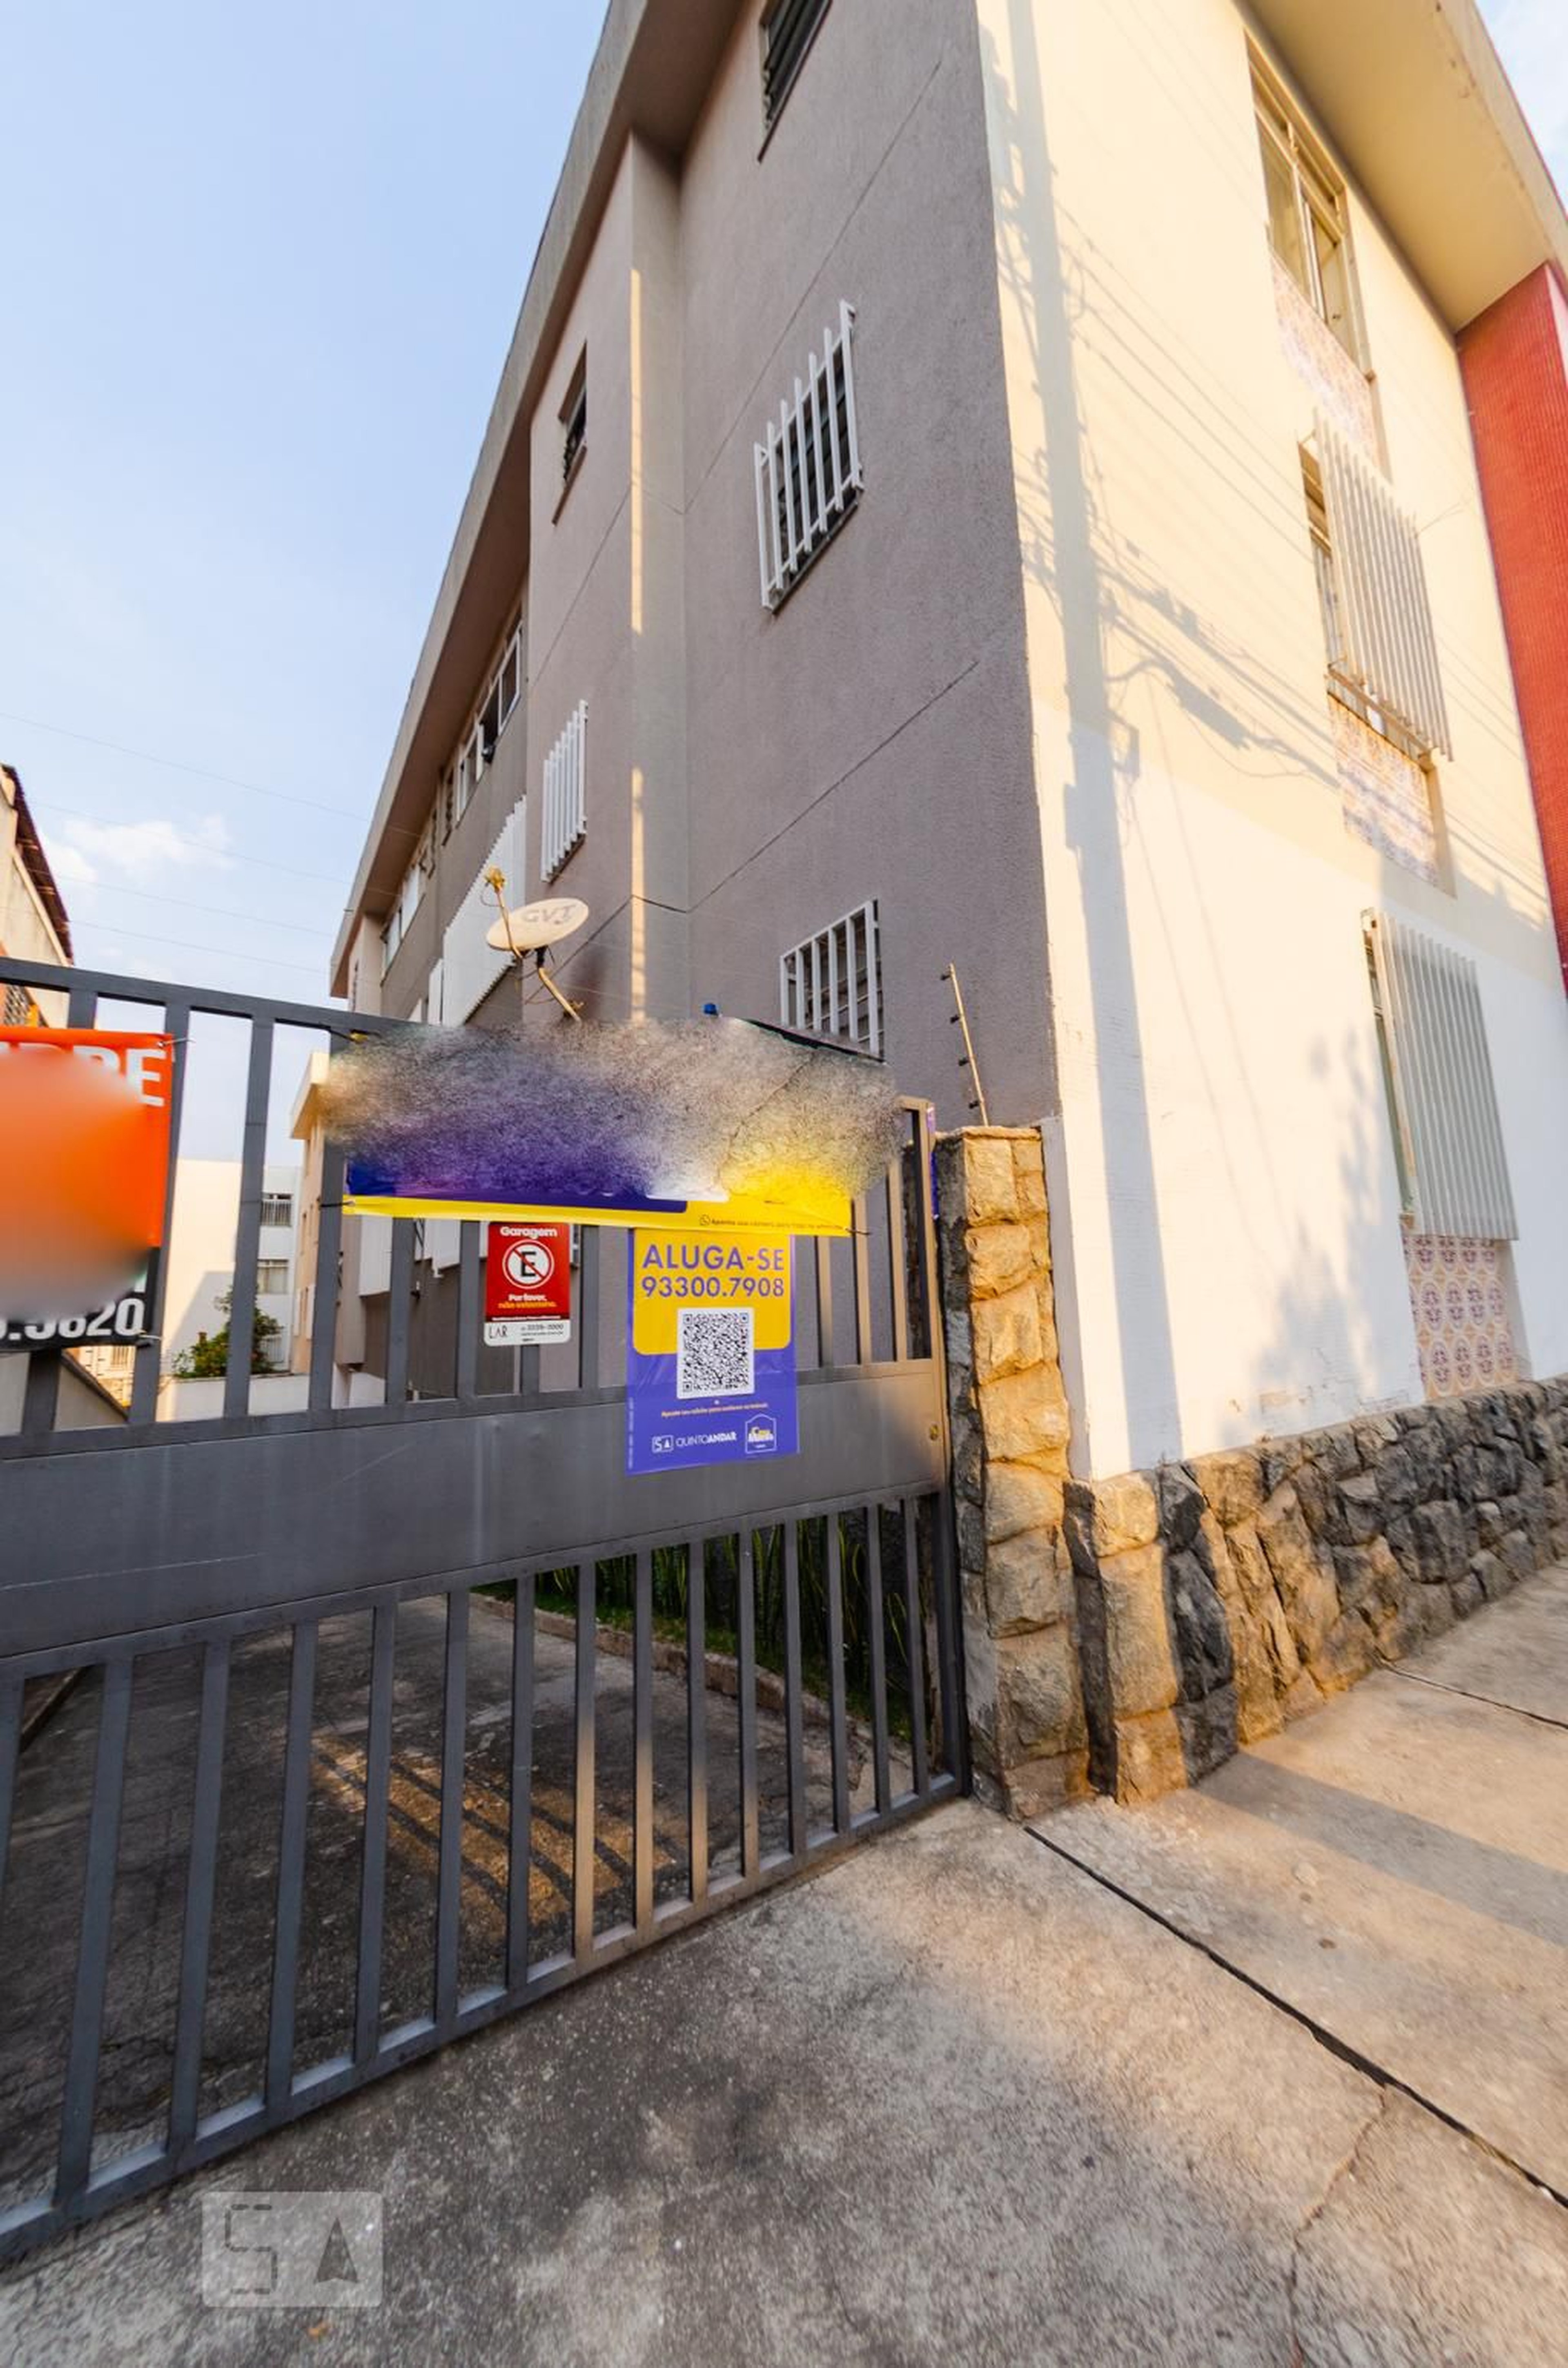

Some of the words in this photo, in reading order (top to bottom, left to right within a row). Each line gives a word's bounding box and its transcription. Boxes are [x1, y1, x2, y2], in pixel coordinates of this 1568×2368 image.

[499, 1226, 558, 1239] Garagem
[642, 1244, 784, 1270] ALUGA-SE
[641, 1276, 784, 1297] 93300.7908
[490, 1325, 508, 1339] LAR
[675, 1431, 737, 1447] QUINTOANDAR
